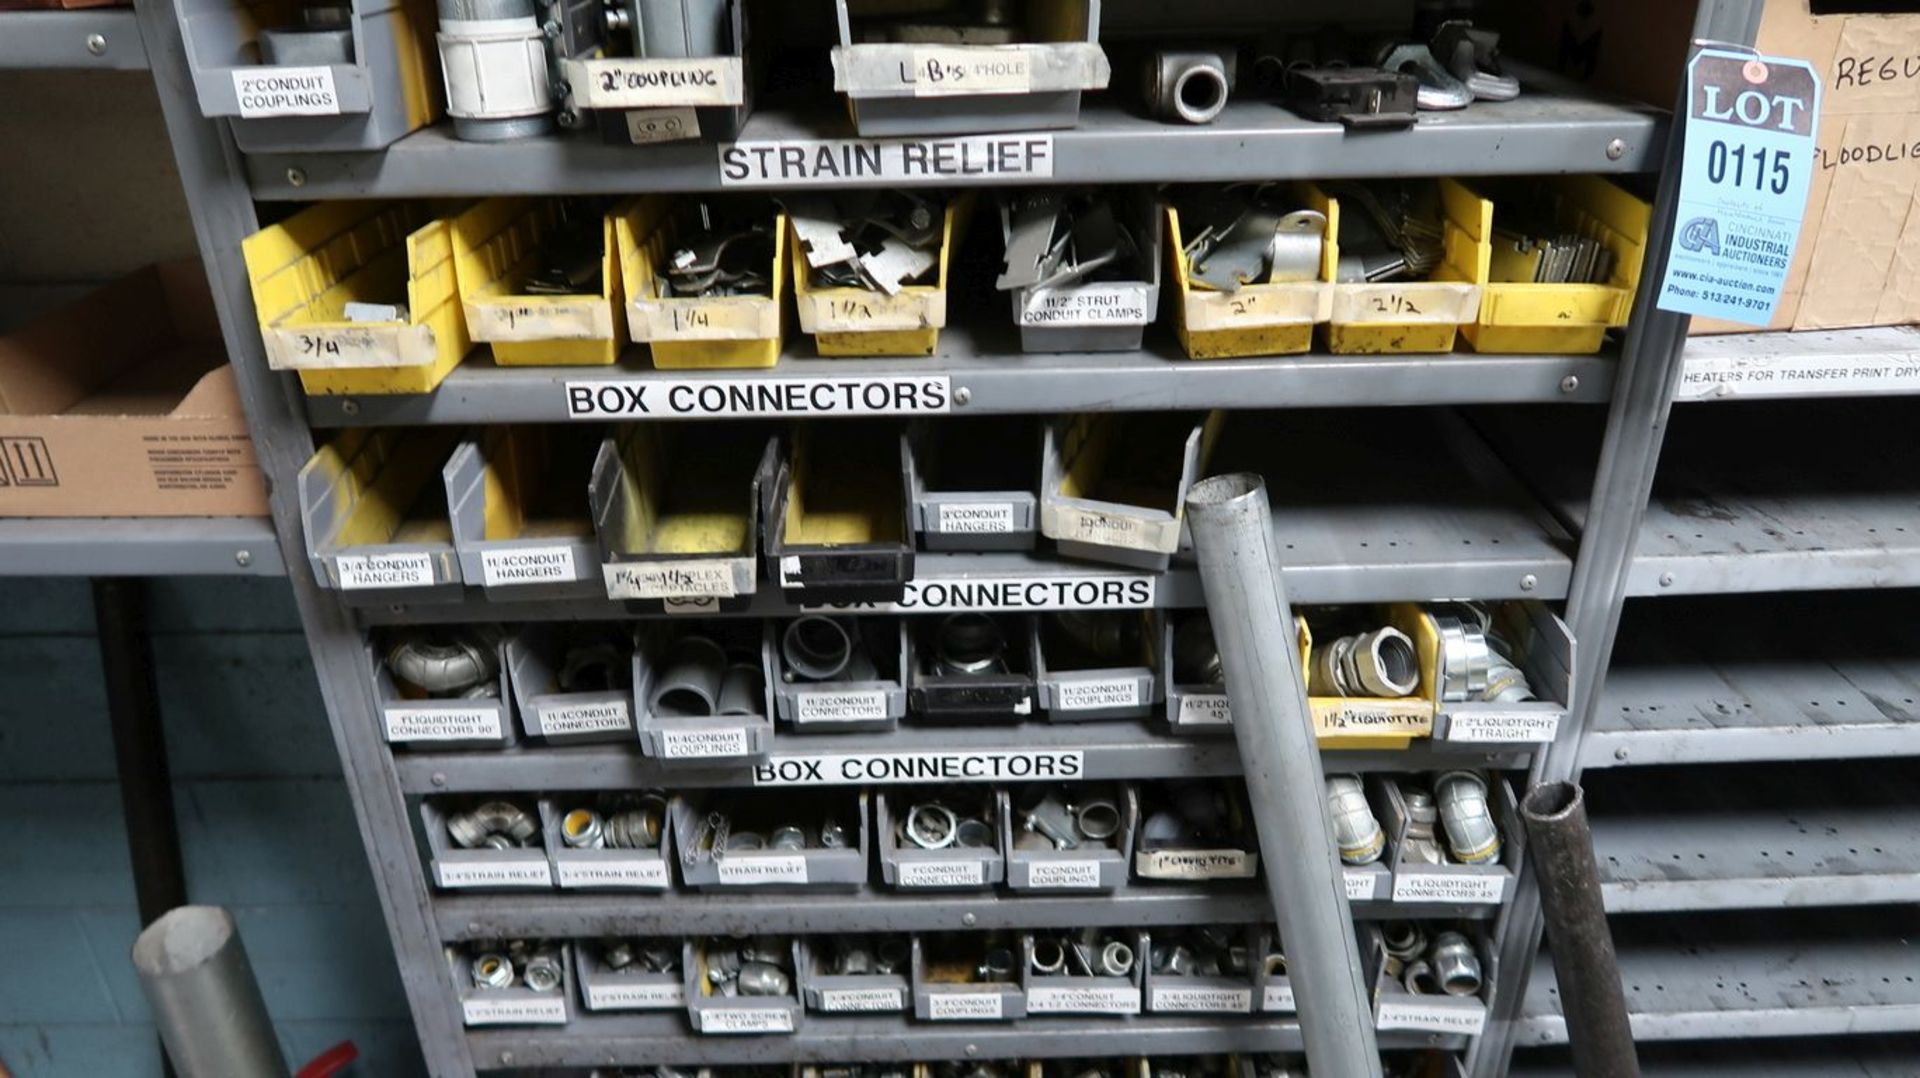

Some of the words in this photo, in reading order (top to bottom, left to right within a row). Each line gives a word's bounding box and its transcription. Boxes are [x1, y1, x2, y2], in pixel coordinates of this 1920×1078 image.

[242, 93, 332, 110] COUPLINGS
[1702, 85, 1804, 131] LOT
[723, 143, 882, 180] STRAIN
[902, 139, 1048, 176] RELIEF
[1707, 141, 1790, 197] 0115
[1728, 220, 1793, 243] CINCINNATI
[1725, 233, 1790, 257] INDUSTRIAL
[1722, 246, 1787, 270] AUCTIONEERS
[1672, 269, 1776, 296] www.cia-auction.com
[1667, 283, 1699, 299] Phone:
[1077, 295, 1121, 306] STRUT
[1024, 308, 1080, 323] CONDUIT
[1087, 307, 1143, 320] CLAMPS
[299, 334, 340, 358] 3/4
[1683, 371, 1744, 384] HEATERS
[1747, 370, 1774, 381] FOR
[1780, 367, 1848, 381] TRANSFER
[1851, 366, 1890, 379] PRINT
[569, 385, 650, 414] BOX
[668, 380, 945, 413] CONNECTORS
[945, 520, 1007, 532] HANGERS
[352, 570, 420, 585] HANGERS
[496, 565, 563, 580] HANGERS
[896, 580, 1151, 608] CONNECTORS
[1065, 694, 1133, 707] COUPLINGS
[801, 706, 882, 718] CONNECTORS
[390, 725, 474, 737] CONNECTORS
[543, 717, 626, 731] CONNECTORS
[670, 743, 741, 757] COUPLINGS
[755, 760, 824, 782] BOX
[841, 754, 1080, 781] CONNECTORS
[508, 869, 546, 880] RELIEF
[625, 869, 662, 879] RELIEF
[1031, 874, 1097, 886] COUPLINGS
[1396, 887, 1477, 899] CONNECTORS
